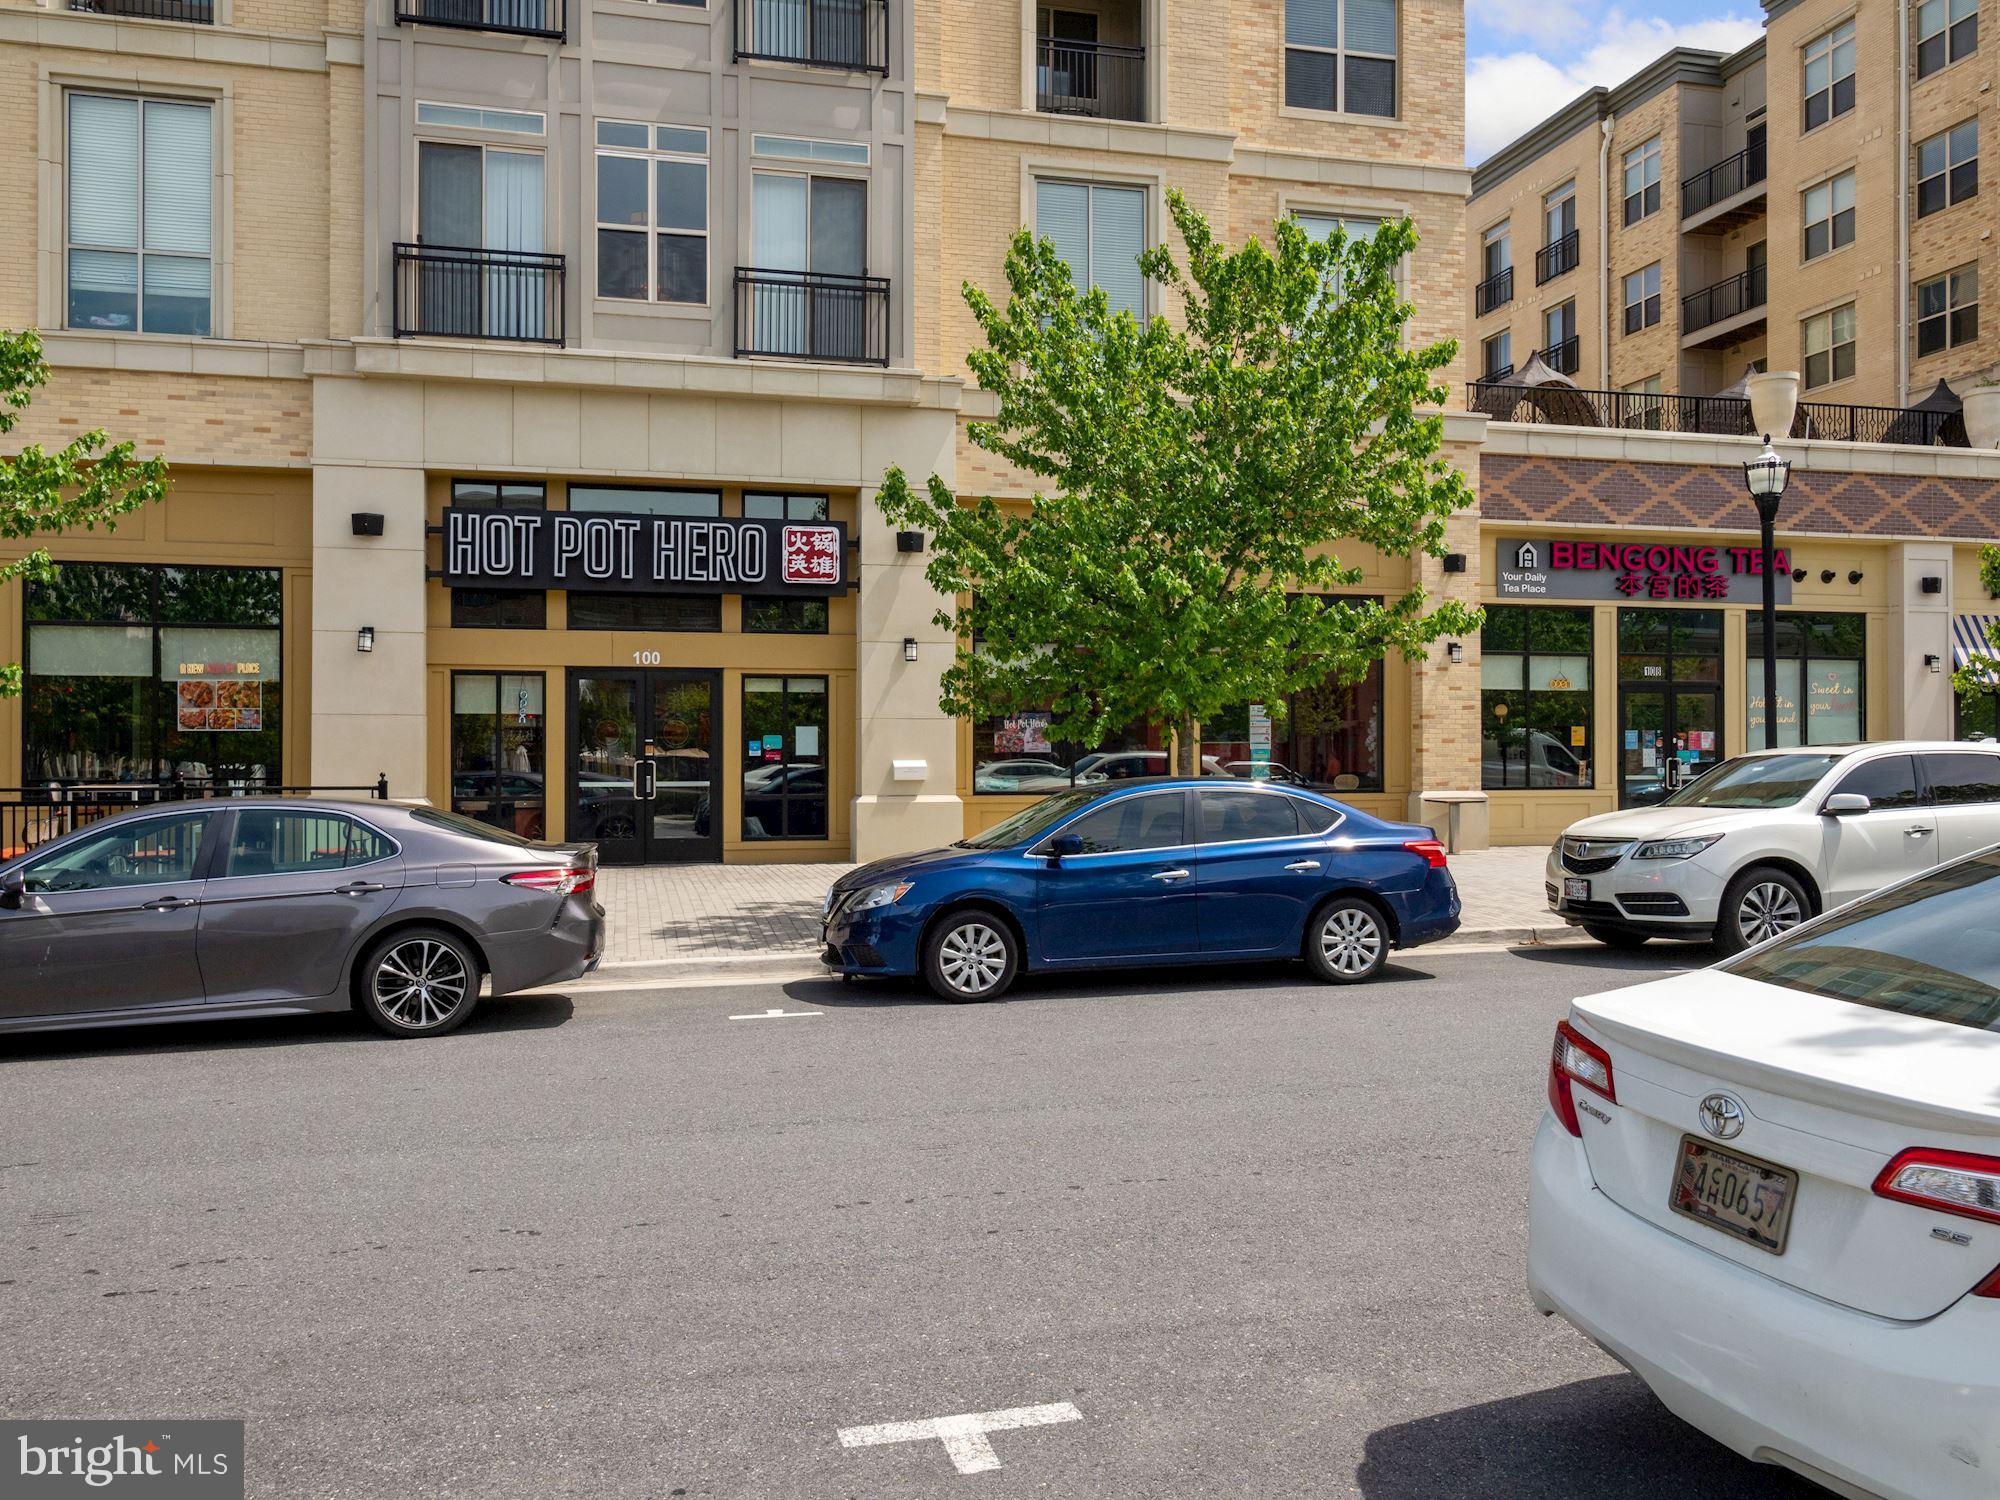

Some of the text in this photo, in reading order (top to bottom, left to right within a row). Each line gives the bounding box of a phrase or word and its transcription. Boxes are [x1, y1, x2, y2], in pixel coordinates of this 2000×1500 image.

[449, 513, 767, 583] HOT POT HERO
[1551, 541, 1791, 575] BENGONG TEA
[1502, 572, 1547, 583] Your Daily
[1503, 583, 1546, 593] Tea Place
[633, 651, 661, 665] 100
[187, 663, 205, 675] NEW
[237, 662, 260, 674] PLACE
[1644, 666, 1661, 676] 108
[1810, 682, 1854, 695] Sweet in
[1810, 702, 1831, 715] your
